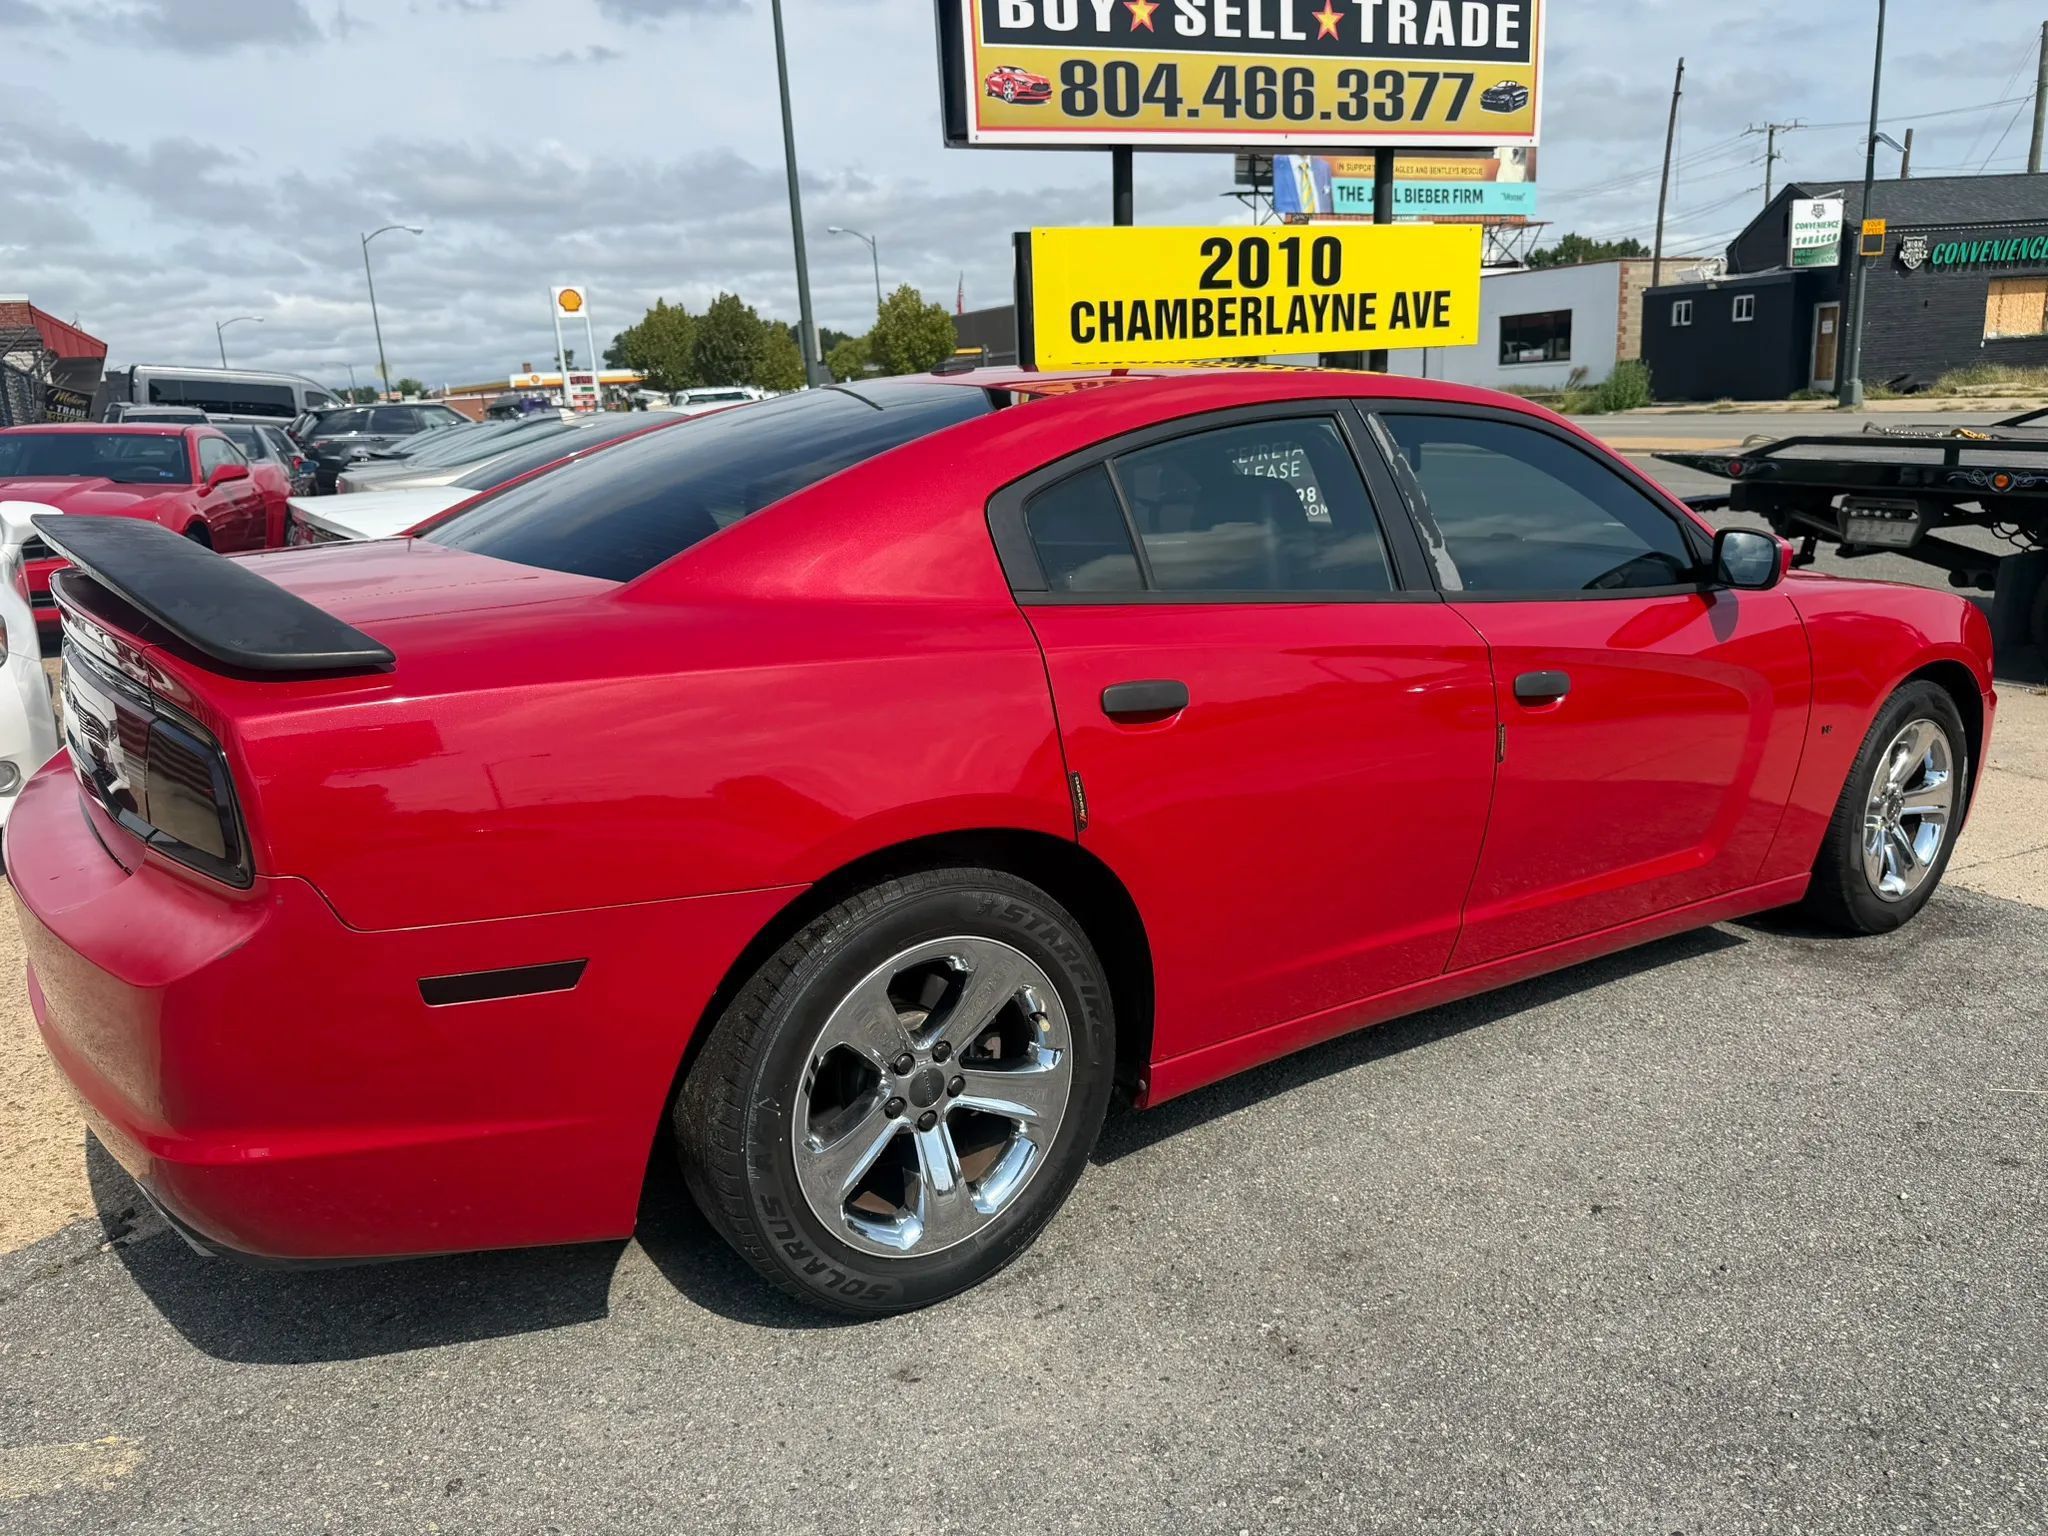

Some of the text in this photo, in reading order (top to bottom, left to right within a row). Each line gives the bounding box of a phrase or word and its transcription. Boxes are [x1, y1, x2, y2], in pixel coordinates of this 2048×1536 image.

[998, 0, 1520, 49] BUY SELL TRADE
[1060, 59, 1475, 122] 804.466.3377
[1346, 164, 1375, 172] SUPPOR
[1338, 186, 1364, 202] THE
[1405, 188, 1450, 204] BIEBER
[1453, 189, 1483, 204] FIRM
[1795, 220, 1840, 230] CONVENIENCE
[1796, 233, 1838, 246] TOBACCO
[1200, 235, 1342, 289] 2010
[1071, 290, 1451, 344] CHAMBERLAYNE AVE
[760, 1193, 894, 1300] SOLARUS
